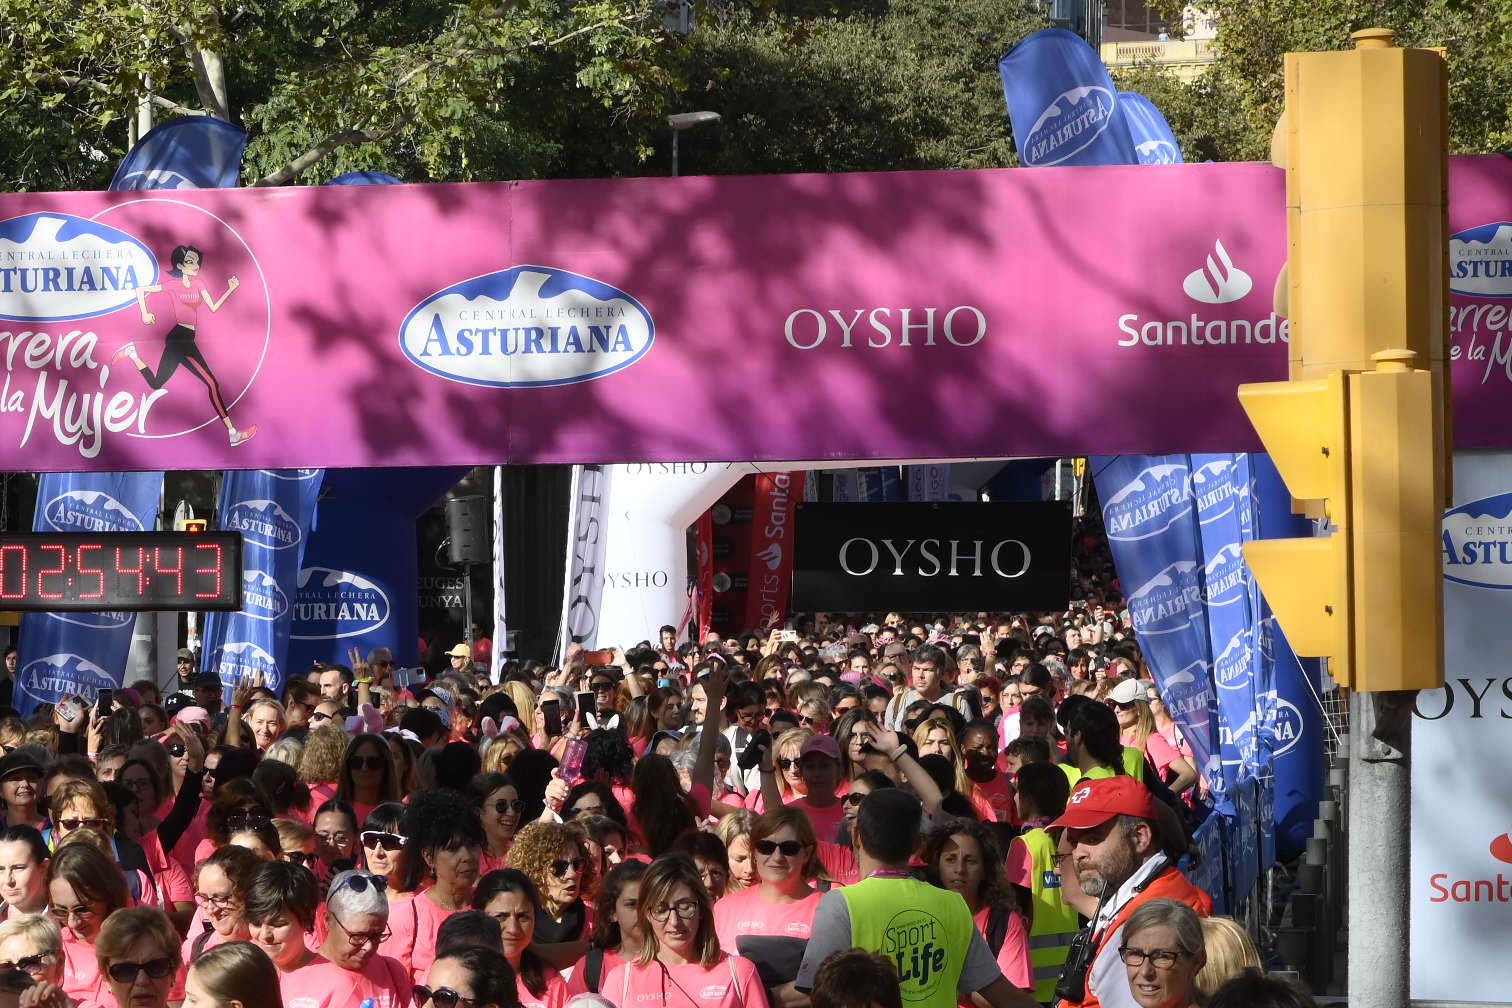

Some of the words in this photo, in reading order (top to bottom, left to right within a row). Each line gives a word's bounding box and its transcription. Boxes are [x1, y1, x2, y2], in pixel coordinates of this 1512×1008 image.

[62, 249, 134, 262] LECHERA
[458, 309, 537, 321] CENTRAL
[545, 306, 627, 319] LECHERA
[784, 306, 987, 349] OYSHO
[420, 313, 634, 358] ASTURIANA
[0, 373, 25, 413] la
[20, 365, 169, 458] Mujer
[0, 543, 221, 598] 02:54:43
[839, 537, 1032, 578] OYSHO
[602, 570, 668, 589] YSHO
[886, 918, 937, 952] Sport
[896, 942, 945, 985] Life
